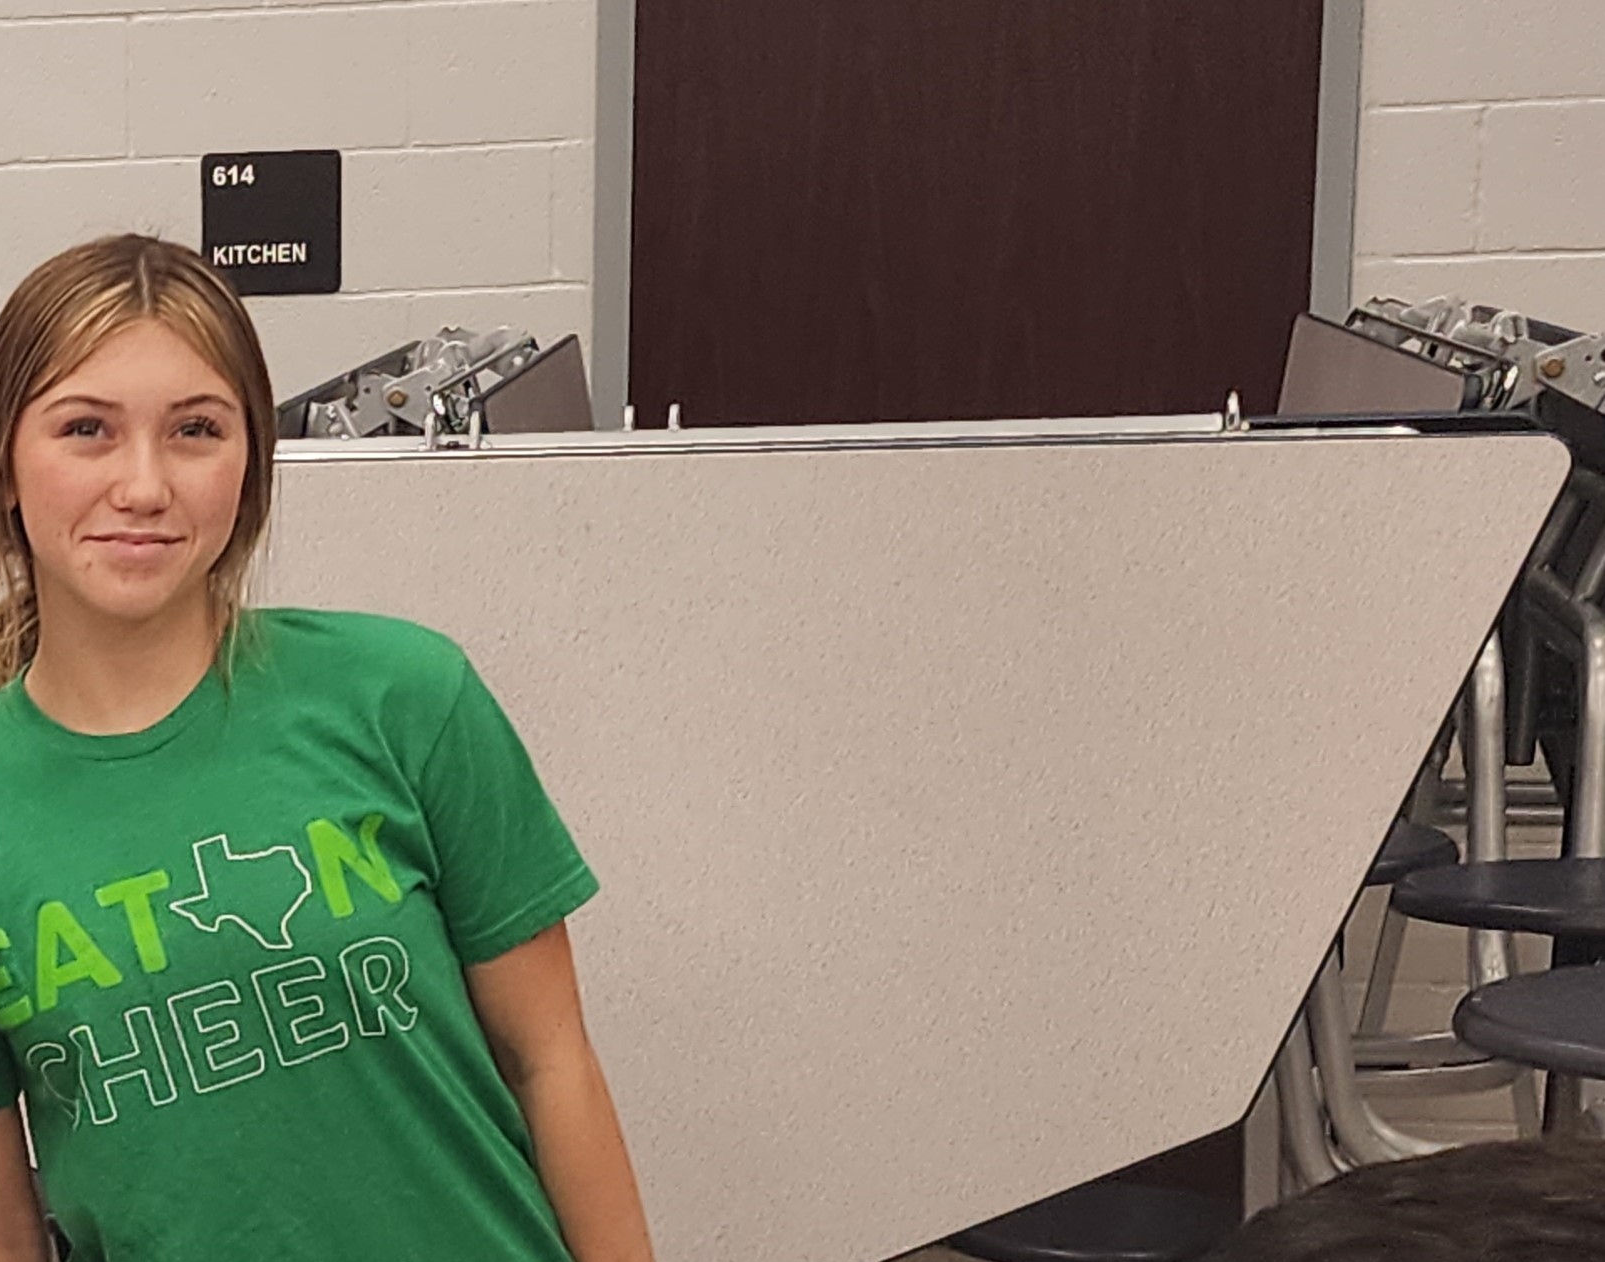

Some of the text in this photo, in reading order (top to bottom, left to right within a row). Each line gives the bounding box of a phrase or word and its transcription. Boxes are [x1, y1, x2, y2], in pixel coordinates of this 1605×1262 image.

[212, 164, 255, 186] 614
[213, 243, 307, 266] KITCHEN
[25, 936, 419, 1132] CHEER
